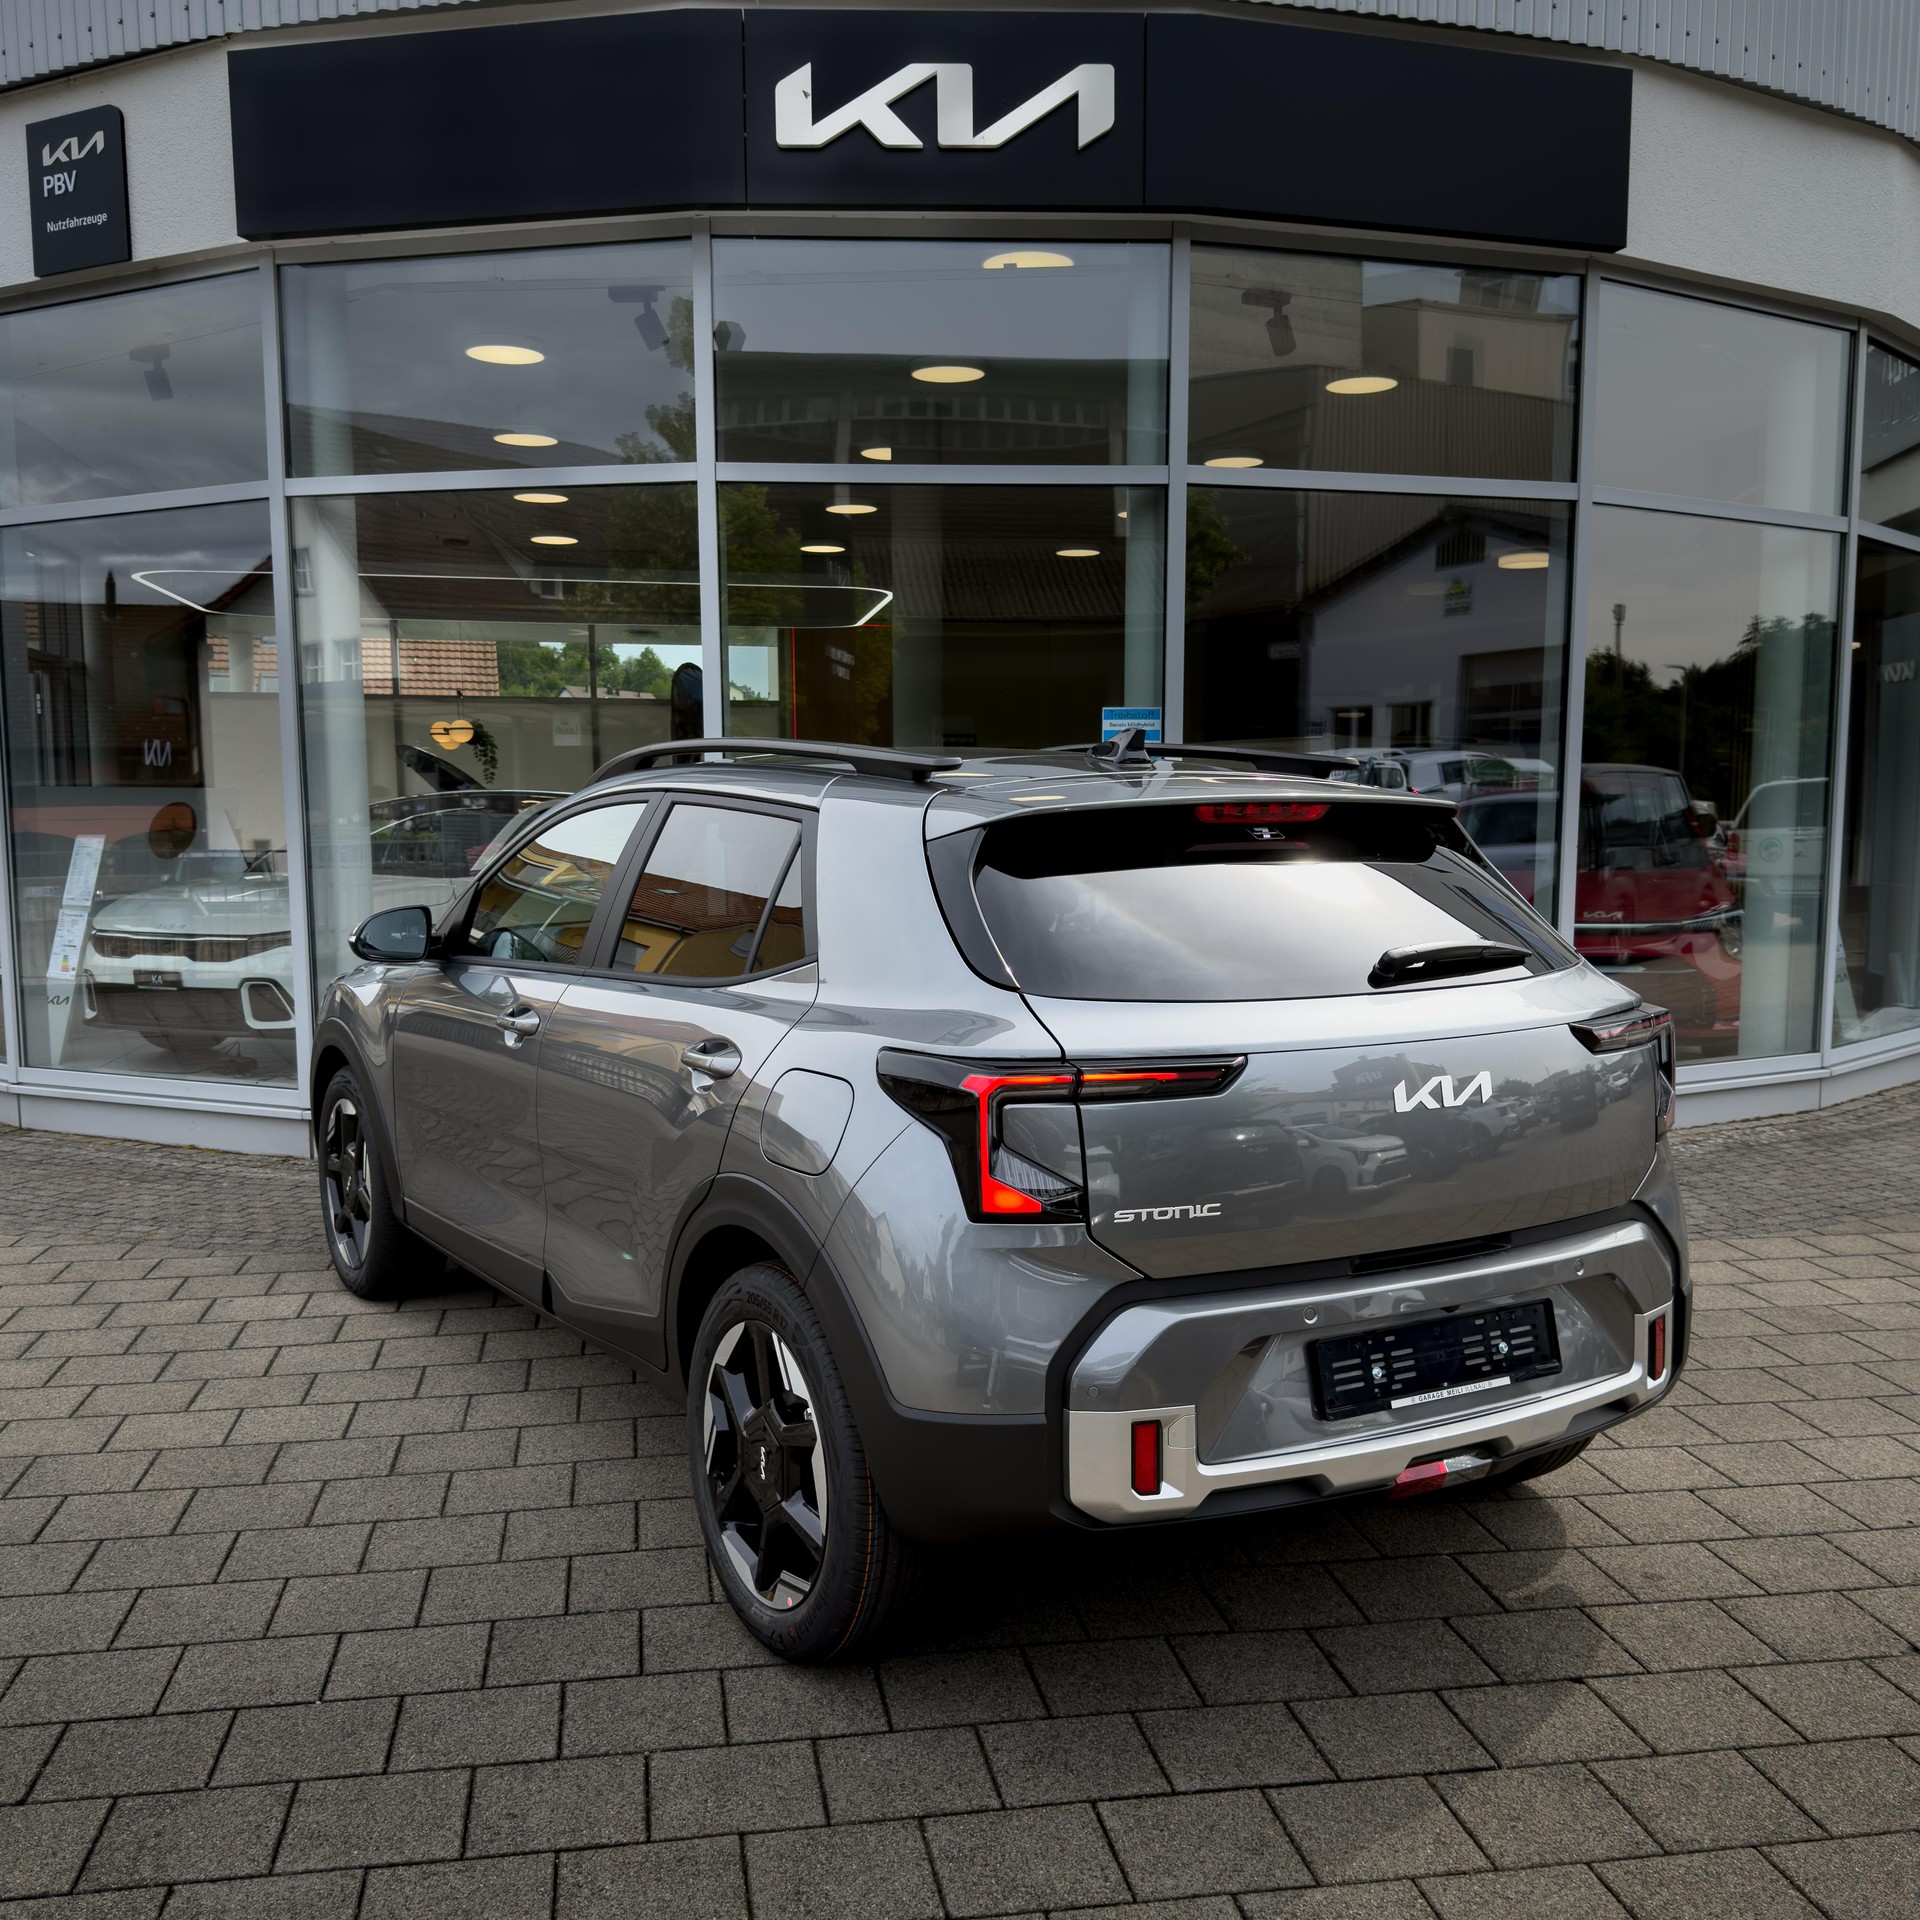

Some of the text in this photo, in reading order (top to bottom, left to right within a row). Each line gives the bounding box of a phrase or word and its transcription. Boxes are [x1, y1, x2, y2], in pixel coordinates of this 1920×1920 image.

[774, 62, 1115, 150] KIA
[42, 130, 105, 167] KIA
[43, 170, 77, 198] PBV
[46, 212, 108, 233] Nutzfahrzeuge
[1109, 710, 1155, 719] Treibstoff
[151, 974, 163, 985] K4
[1393, 1070, 1493, 1113] KIA
[1113, 1202, 1222, 1224] STONIC
[746, 1291, 772, 1314] 205/55
[773, 1308, 780, 1322] R
[1418, 1391, 1444, 1402] GARAGE
